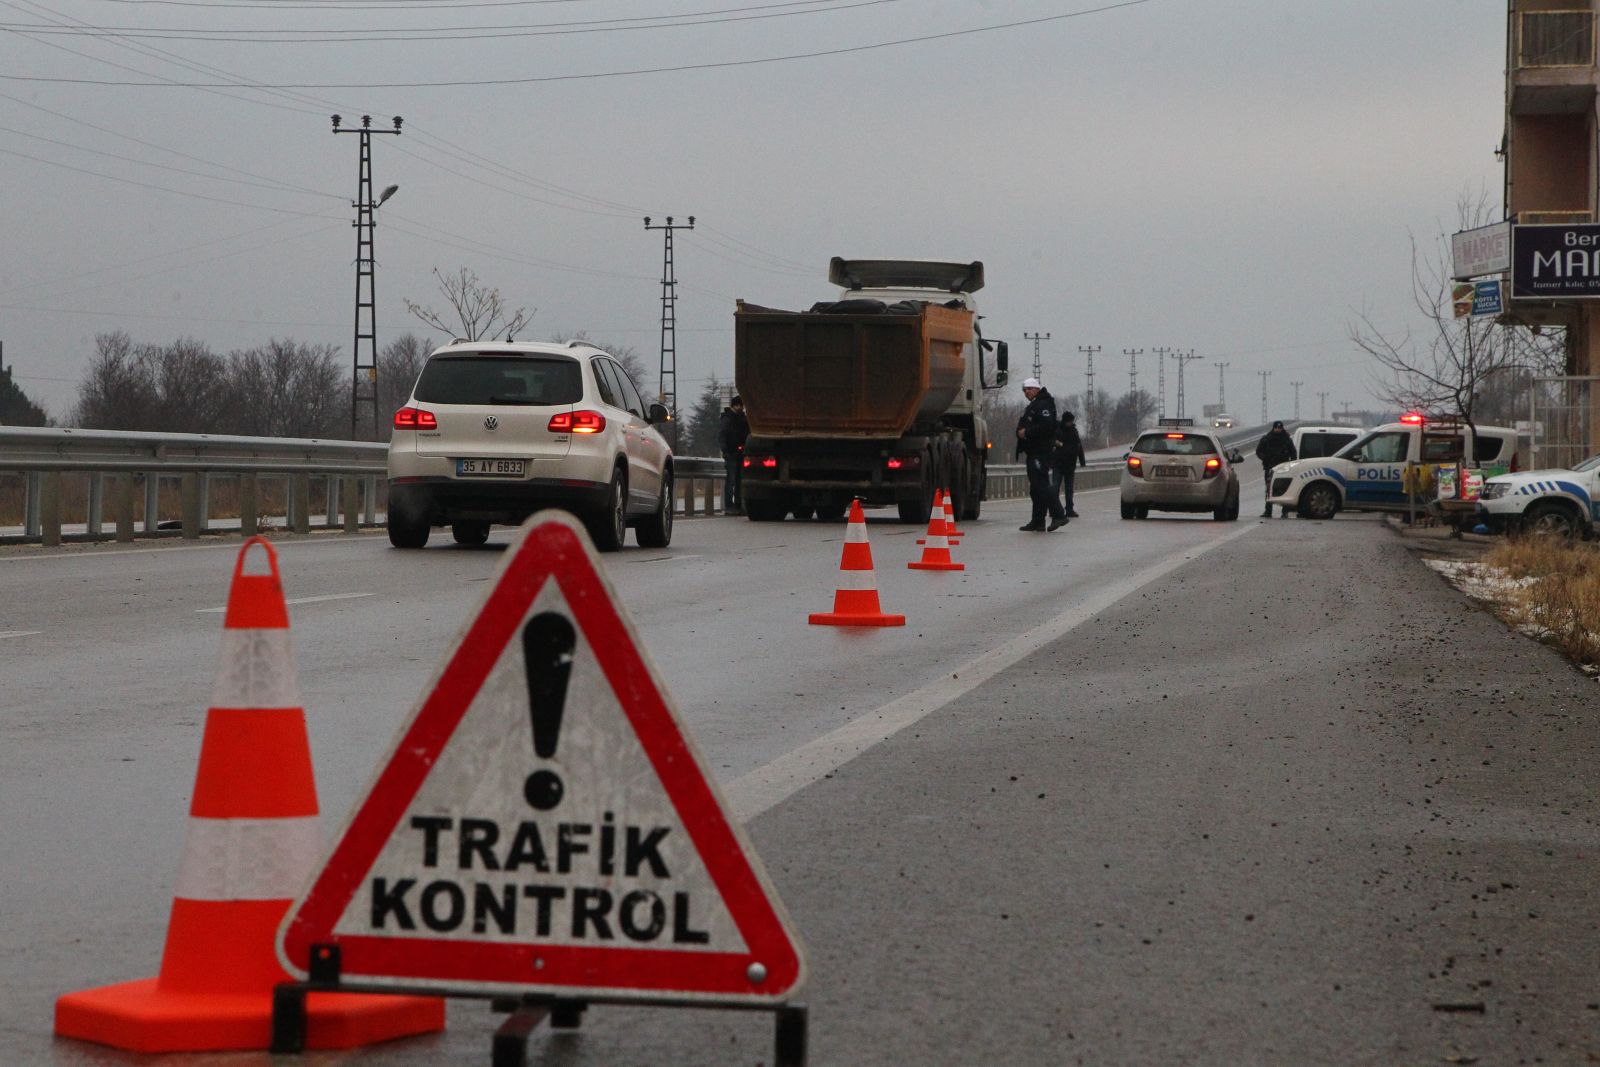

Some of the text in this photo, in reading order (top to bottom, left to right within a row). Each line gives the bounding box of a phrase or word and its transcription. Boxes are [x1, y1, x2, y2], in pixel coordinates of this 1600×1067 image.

[1462, 232, 1509, 265] MARKET
[1564, 231, 1600, 246] Ber
[463, 461, 522, 473] 35 AY 6833
[1357, 465, 1401, 480] POLİS
[411, 811, 672, 879] TRAFİK
[371, 877, 709, 945] KONTROL
